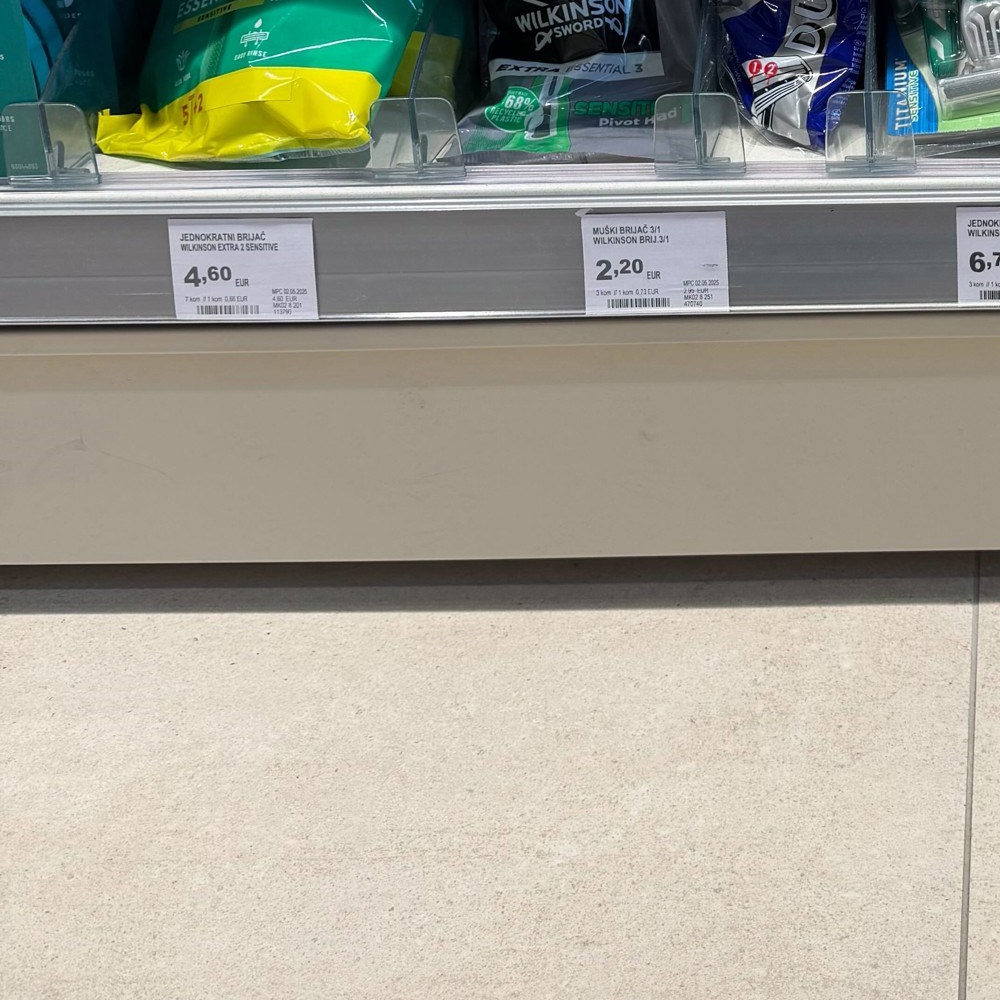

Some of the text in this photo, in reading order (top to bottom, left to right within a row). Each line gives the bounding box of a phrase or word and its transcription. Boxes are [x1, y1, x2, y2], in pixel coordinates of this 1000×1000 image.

[555, 18, 604, 39] SWORD
[599, 118, 640, 127] Pivot
[592, 225, 618, 235] MUŠKI
[620, 224, 648, 234] BRIJAČ
[180, 231, 266, 242] JEDNOKRATNI BRIJAČ
[639, 236, 669, 244] BRIJ.3/1
[245, 243, 278, 251] SENSITIVE
[596, 258, 643, 280] 2,20
[184, 266, 232, 287] 4,60
